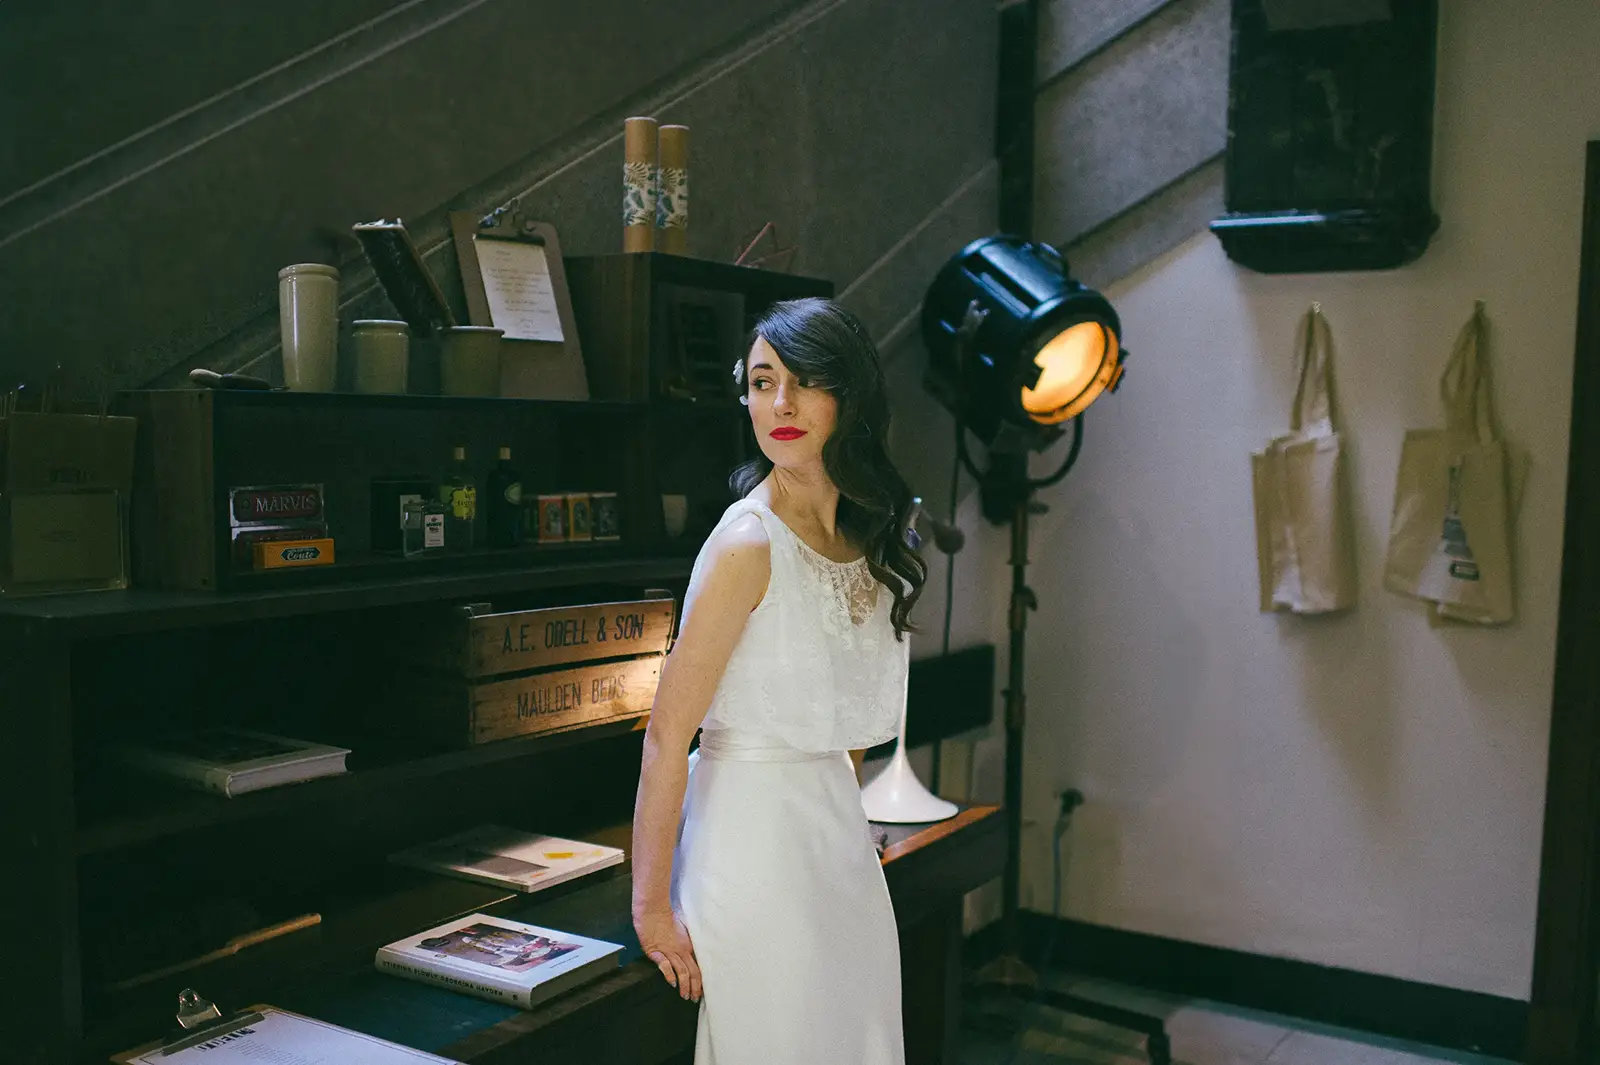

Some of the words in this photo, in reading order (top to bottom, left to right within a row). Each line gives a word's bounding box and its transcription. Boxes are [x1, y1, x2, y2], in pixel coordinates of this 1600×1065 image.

[256, 495, 316, 513] MARVIS
[502, 624, 535, 653] A.E.
[545, 619, 589, 648] ODELL
[597, 617, 607, 642] &
[614, 613, 645, 641] SON
[517, 682, 582, 720] MAULDEN
